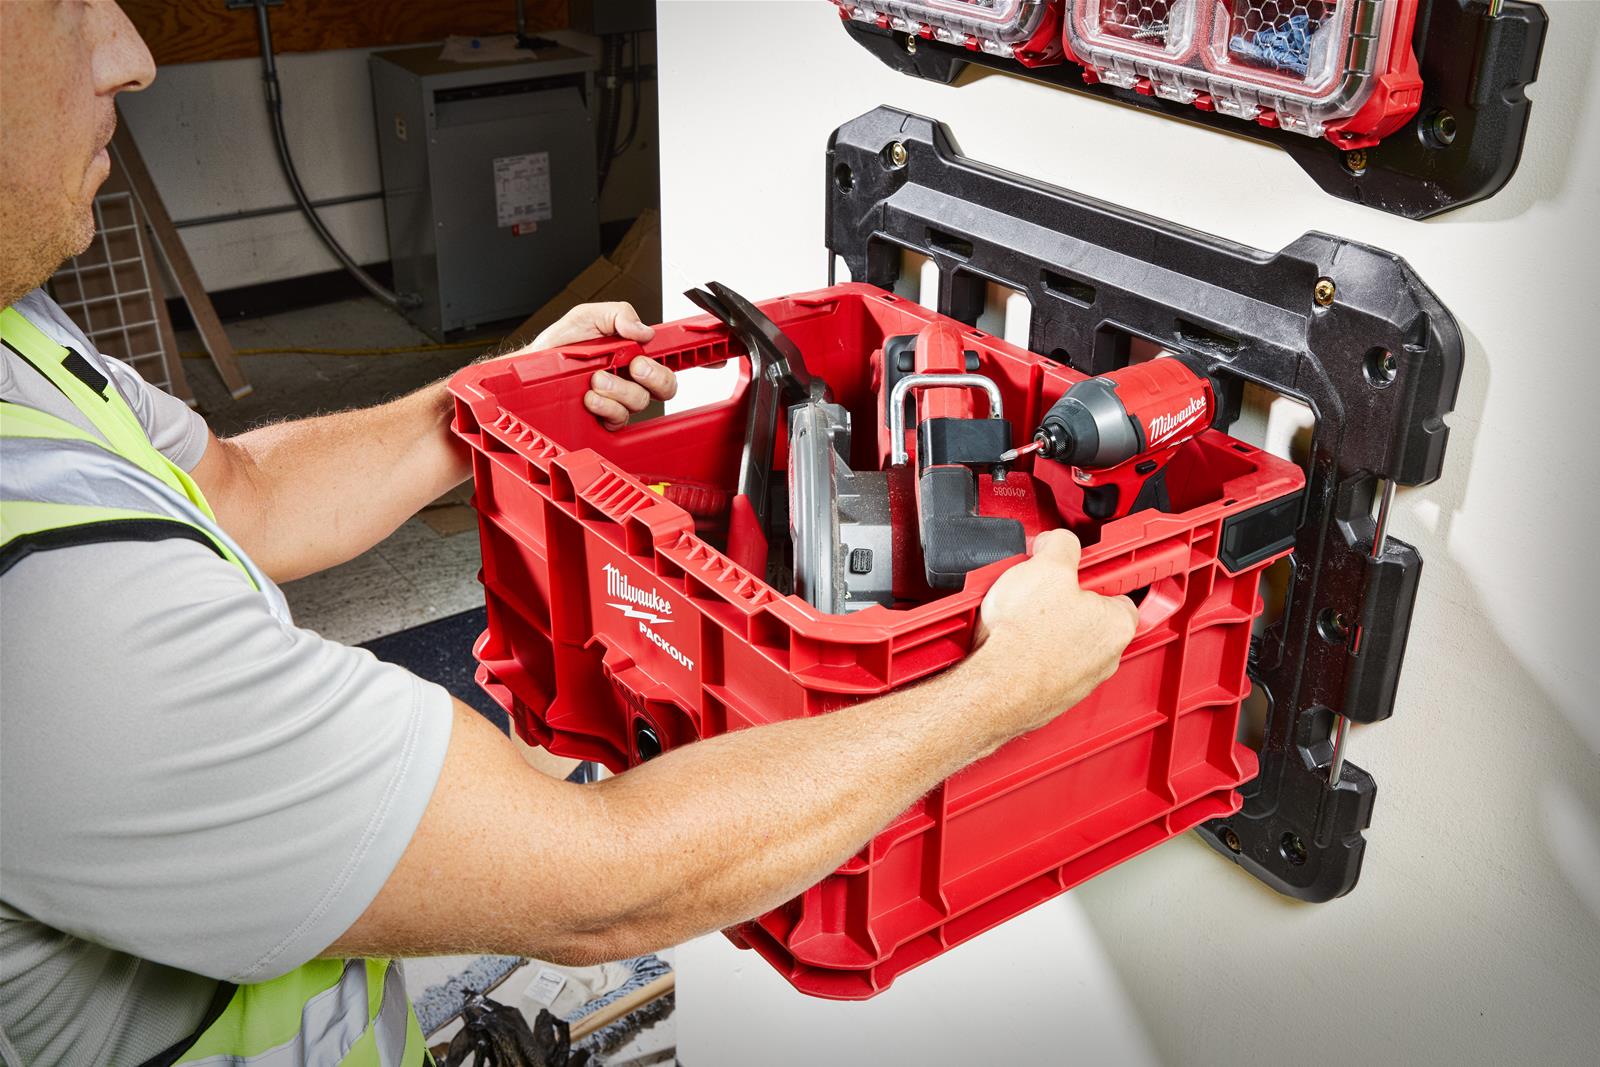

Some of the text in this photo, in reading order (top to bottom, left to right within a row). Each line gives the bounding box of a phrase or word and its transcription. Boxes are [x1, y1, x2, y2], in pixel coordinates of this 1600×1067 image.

[1148, 395, 1207, 443] Milwaukee
[602, 562, 673, 615] Milwaukee
[639, 621, 694, 671] PACKOUT
